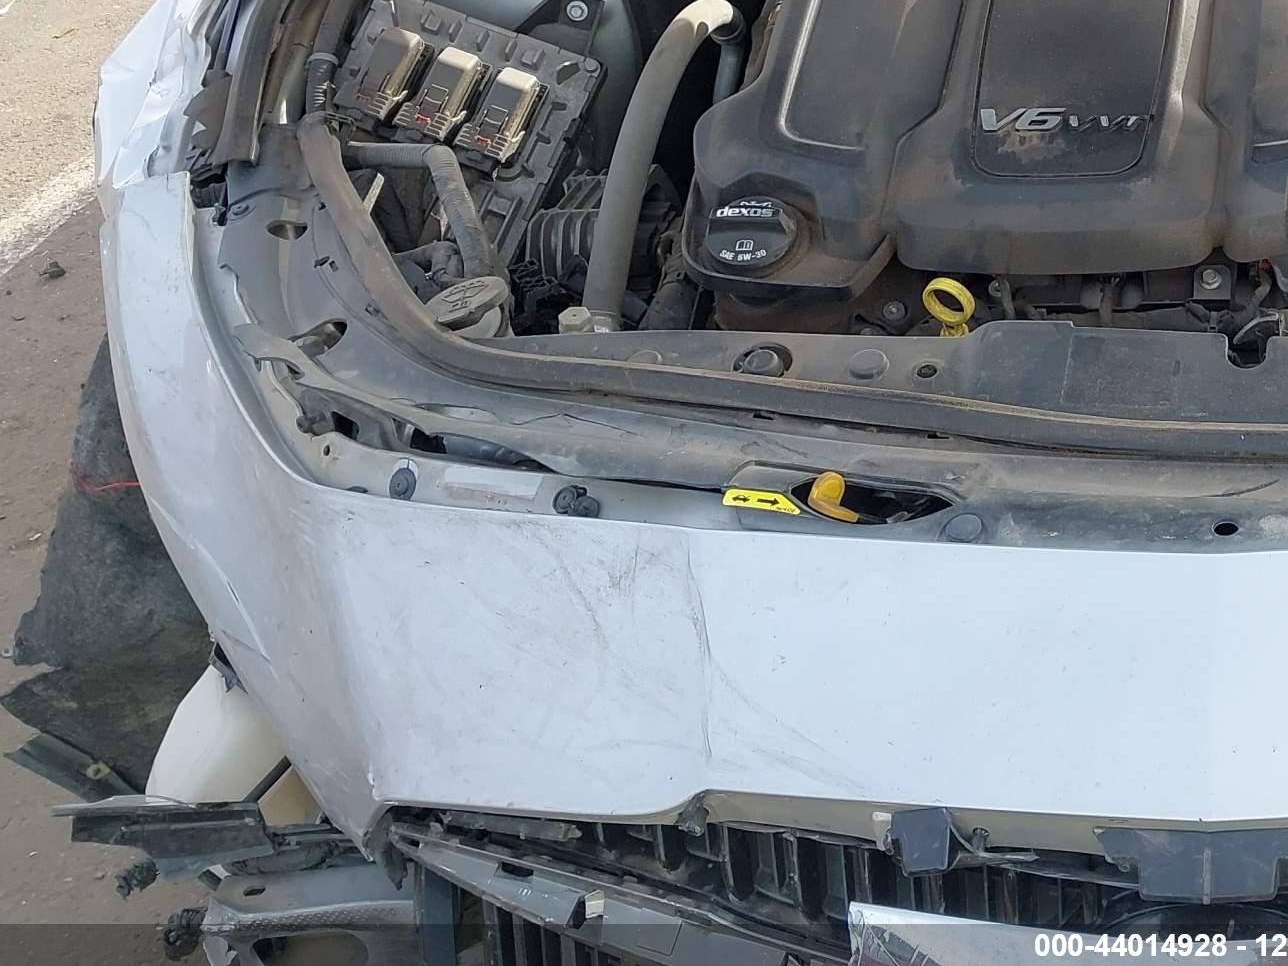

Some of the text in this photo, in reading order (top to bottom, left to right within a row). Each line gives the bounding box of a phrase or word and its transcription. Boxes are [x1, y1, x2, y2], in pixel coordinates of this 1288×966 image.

[980, 107, 1067, 131] V6
[716, 206, 776, 218] dexos
[719, 249, 735, 261] SAE
